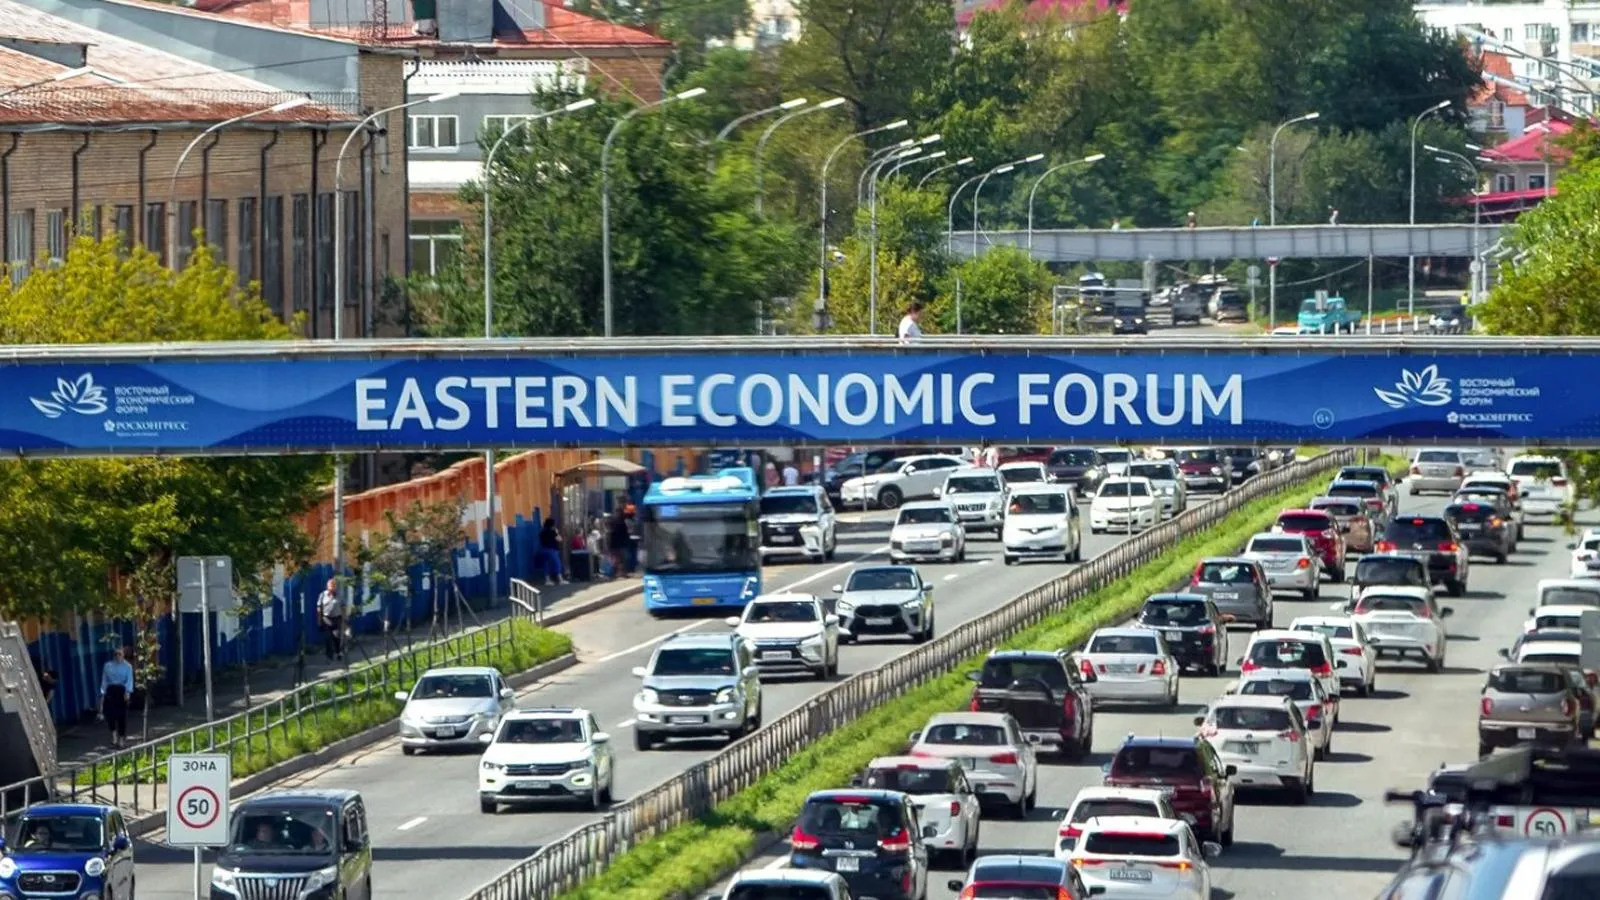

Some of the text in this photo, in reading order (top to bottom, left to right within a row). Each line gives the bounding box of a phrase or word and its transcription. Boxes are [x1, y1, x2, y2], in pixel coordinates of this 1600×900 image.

[1459, 377, 1515, 387] ВОСТОЧНЫЙ
[114, 385, 169, 395] ВОСТОЧНЫЙ
[1459, 387, 1540, 396] ЭКОНОМИЧЕСКИЙ
[115, 395, 195, 405] ЭКОНОМИЧЕСКИЙ
[355, 373, 1243, 430] EASTERN ECONOMIC FORUM
[1459, 397, 1493, 406] ФОРУМ
[115, 405, 148, 414] ФОРУМ
[1459, 412, 1533, 422] РОСКОНГРЕСС
[116, 420, 189, 431] РОСКОНГРЕСС
[183, 760, 217, 771] ЗОНА
[187, 798, 209, 815] 50
[1535, 820, 1556, 836] 50
